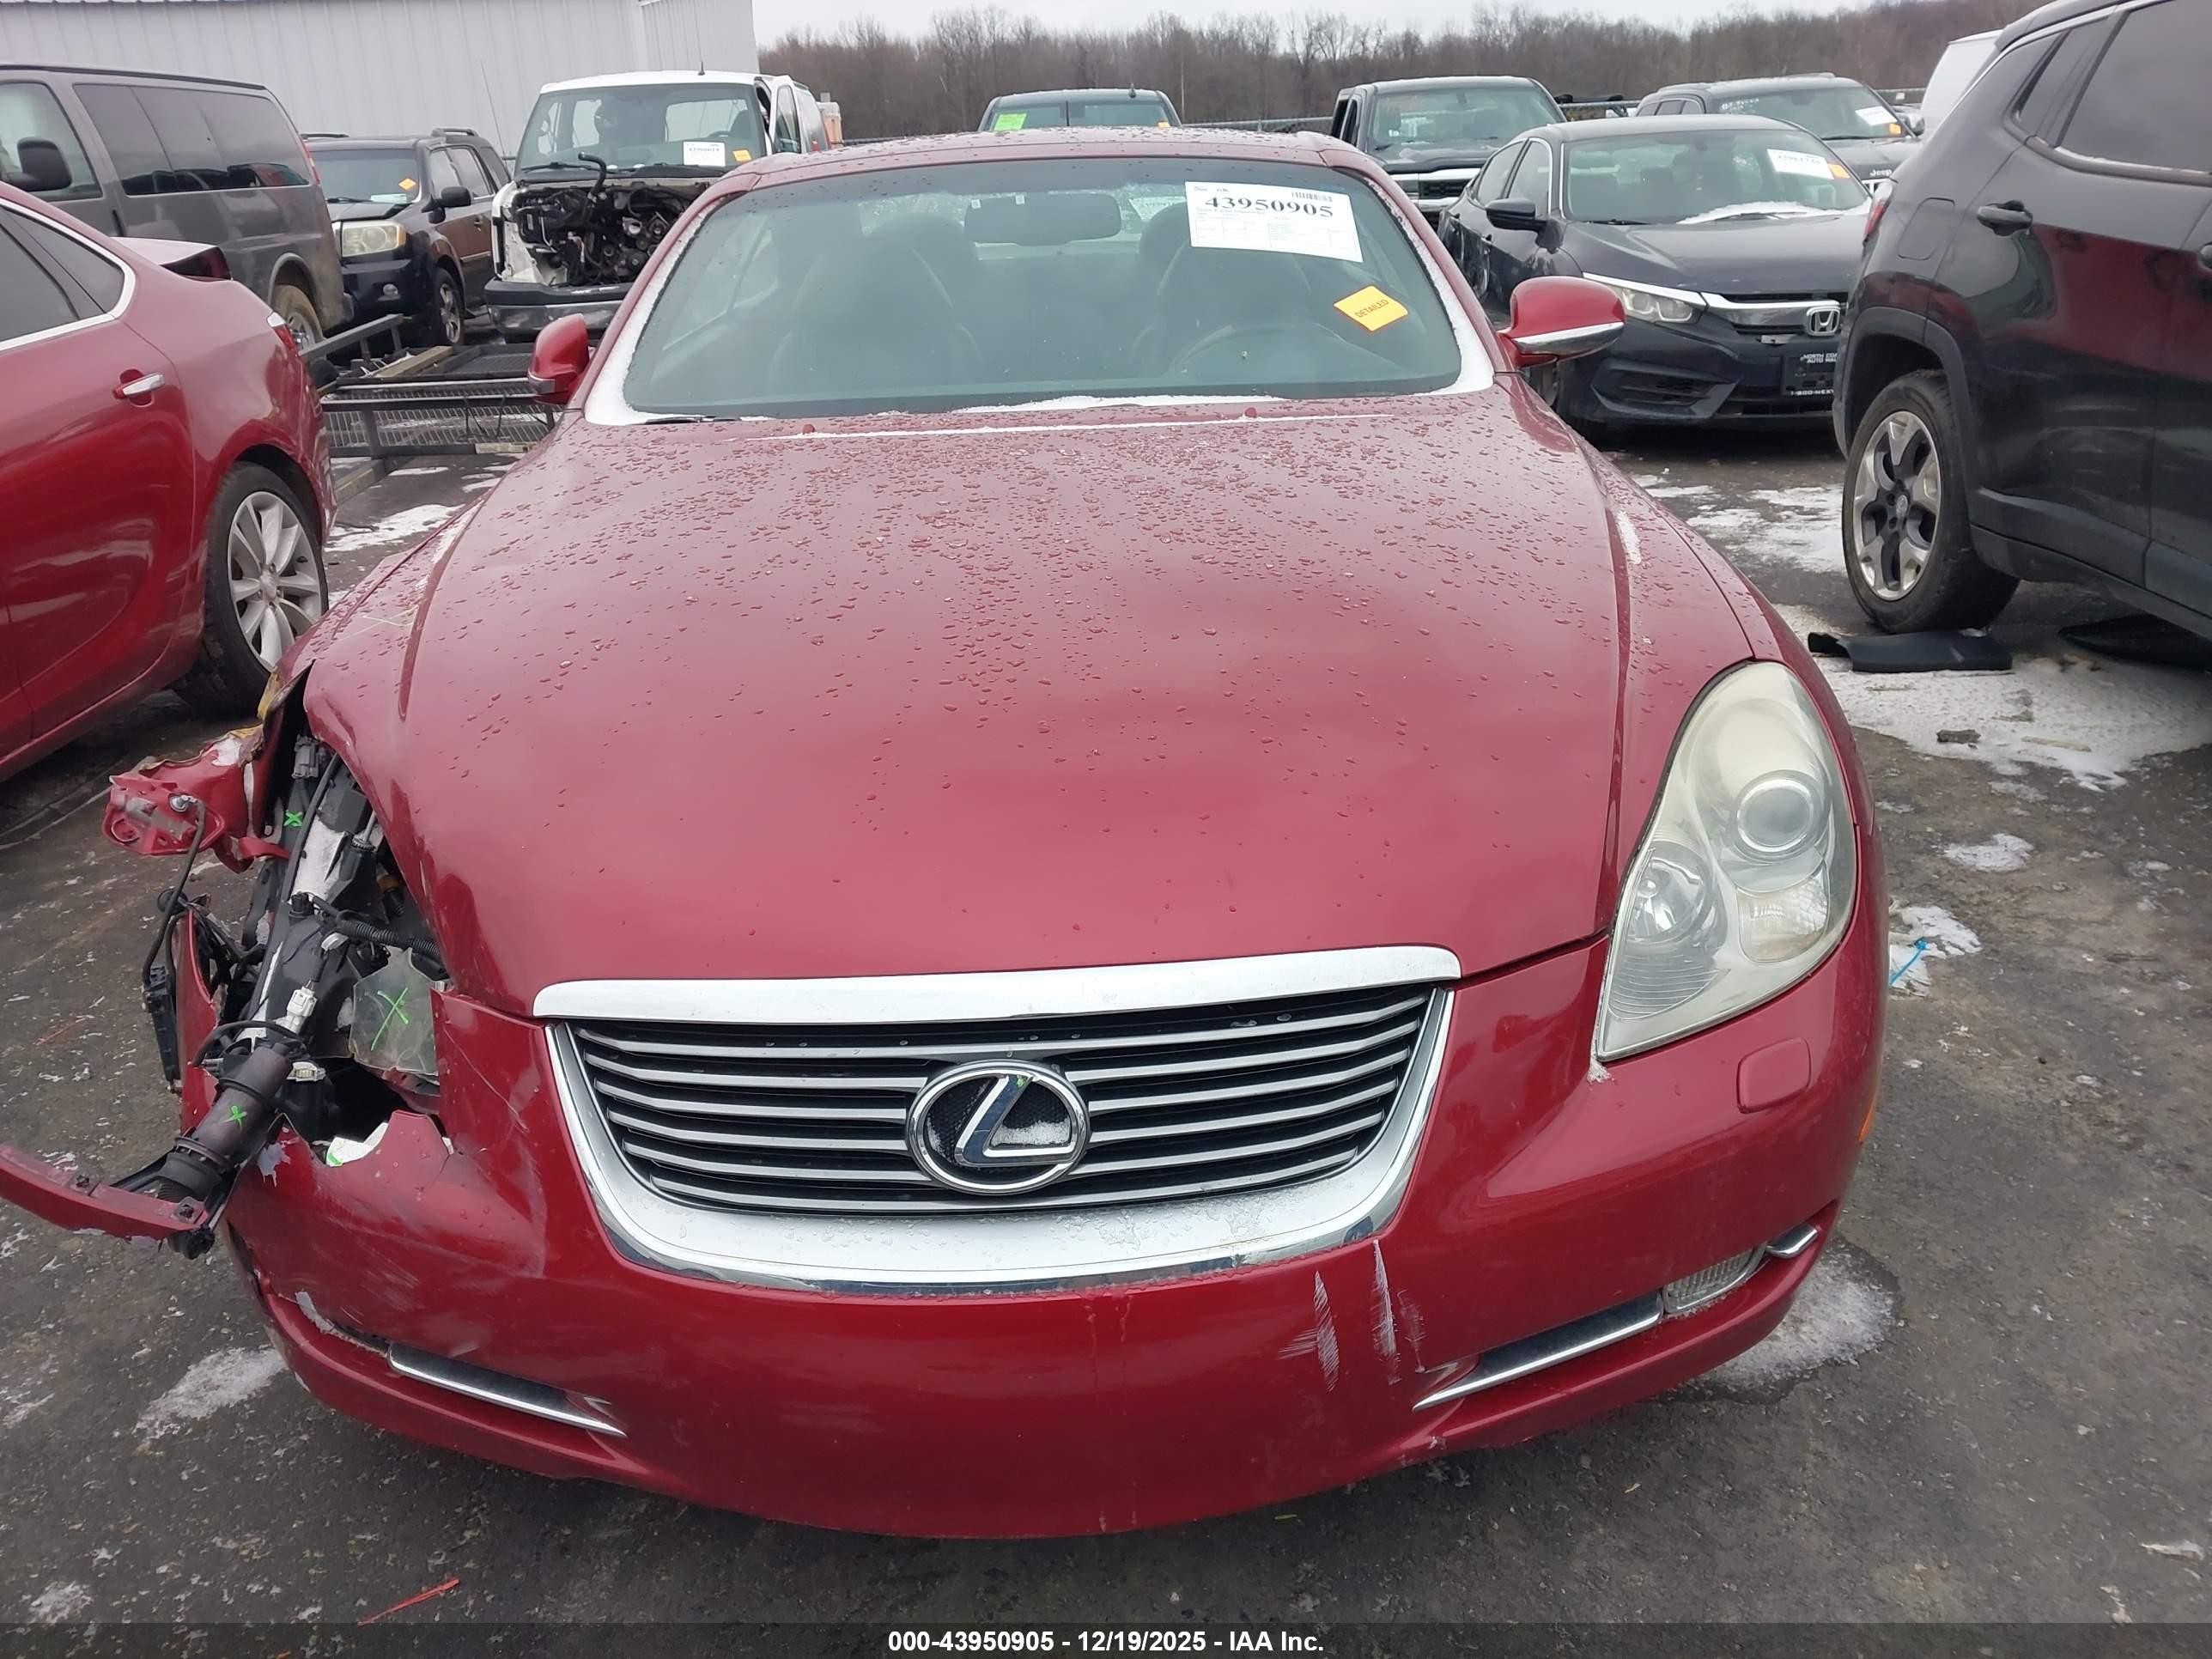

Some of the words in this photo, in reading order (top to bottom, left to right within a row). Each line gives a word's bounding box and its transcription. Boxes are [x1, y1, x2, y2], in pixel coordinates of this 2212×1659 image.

[1870, 170, 1895, 179] Jeep
[1205, 196, 1334, 218] 43950905
[1354, 299, 1389, 318] DETAILED
